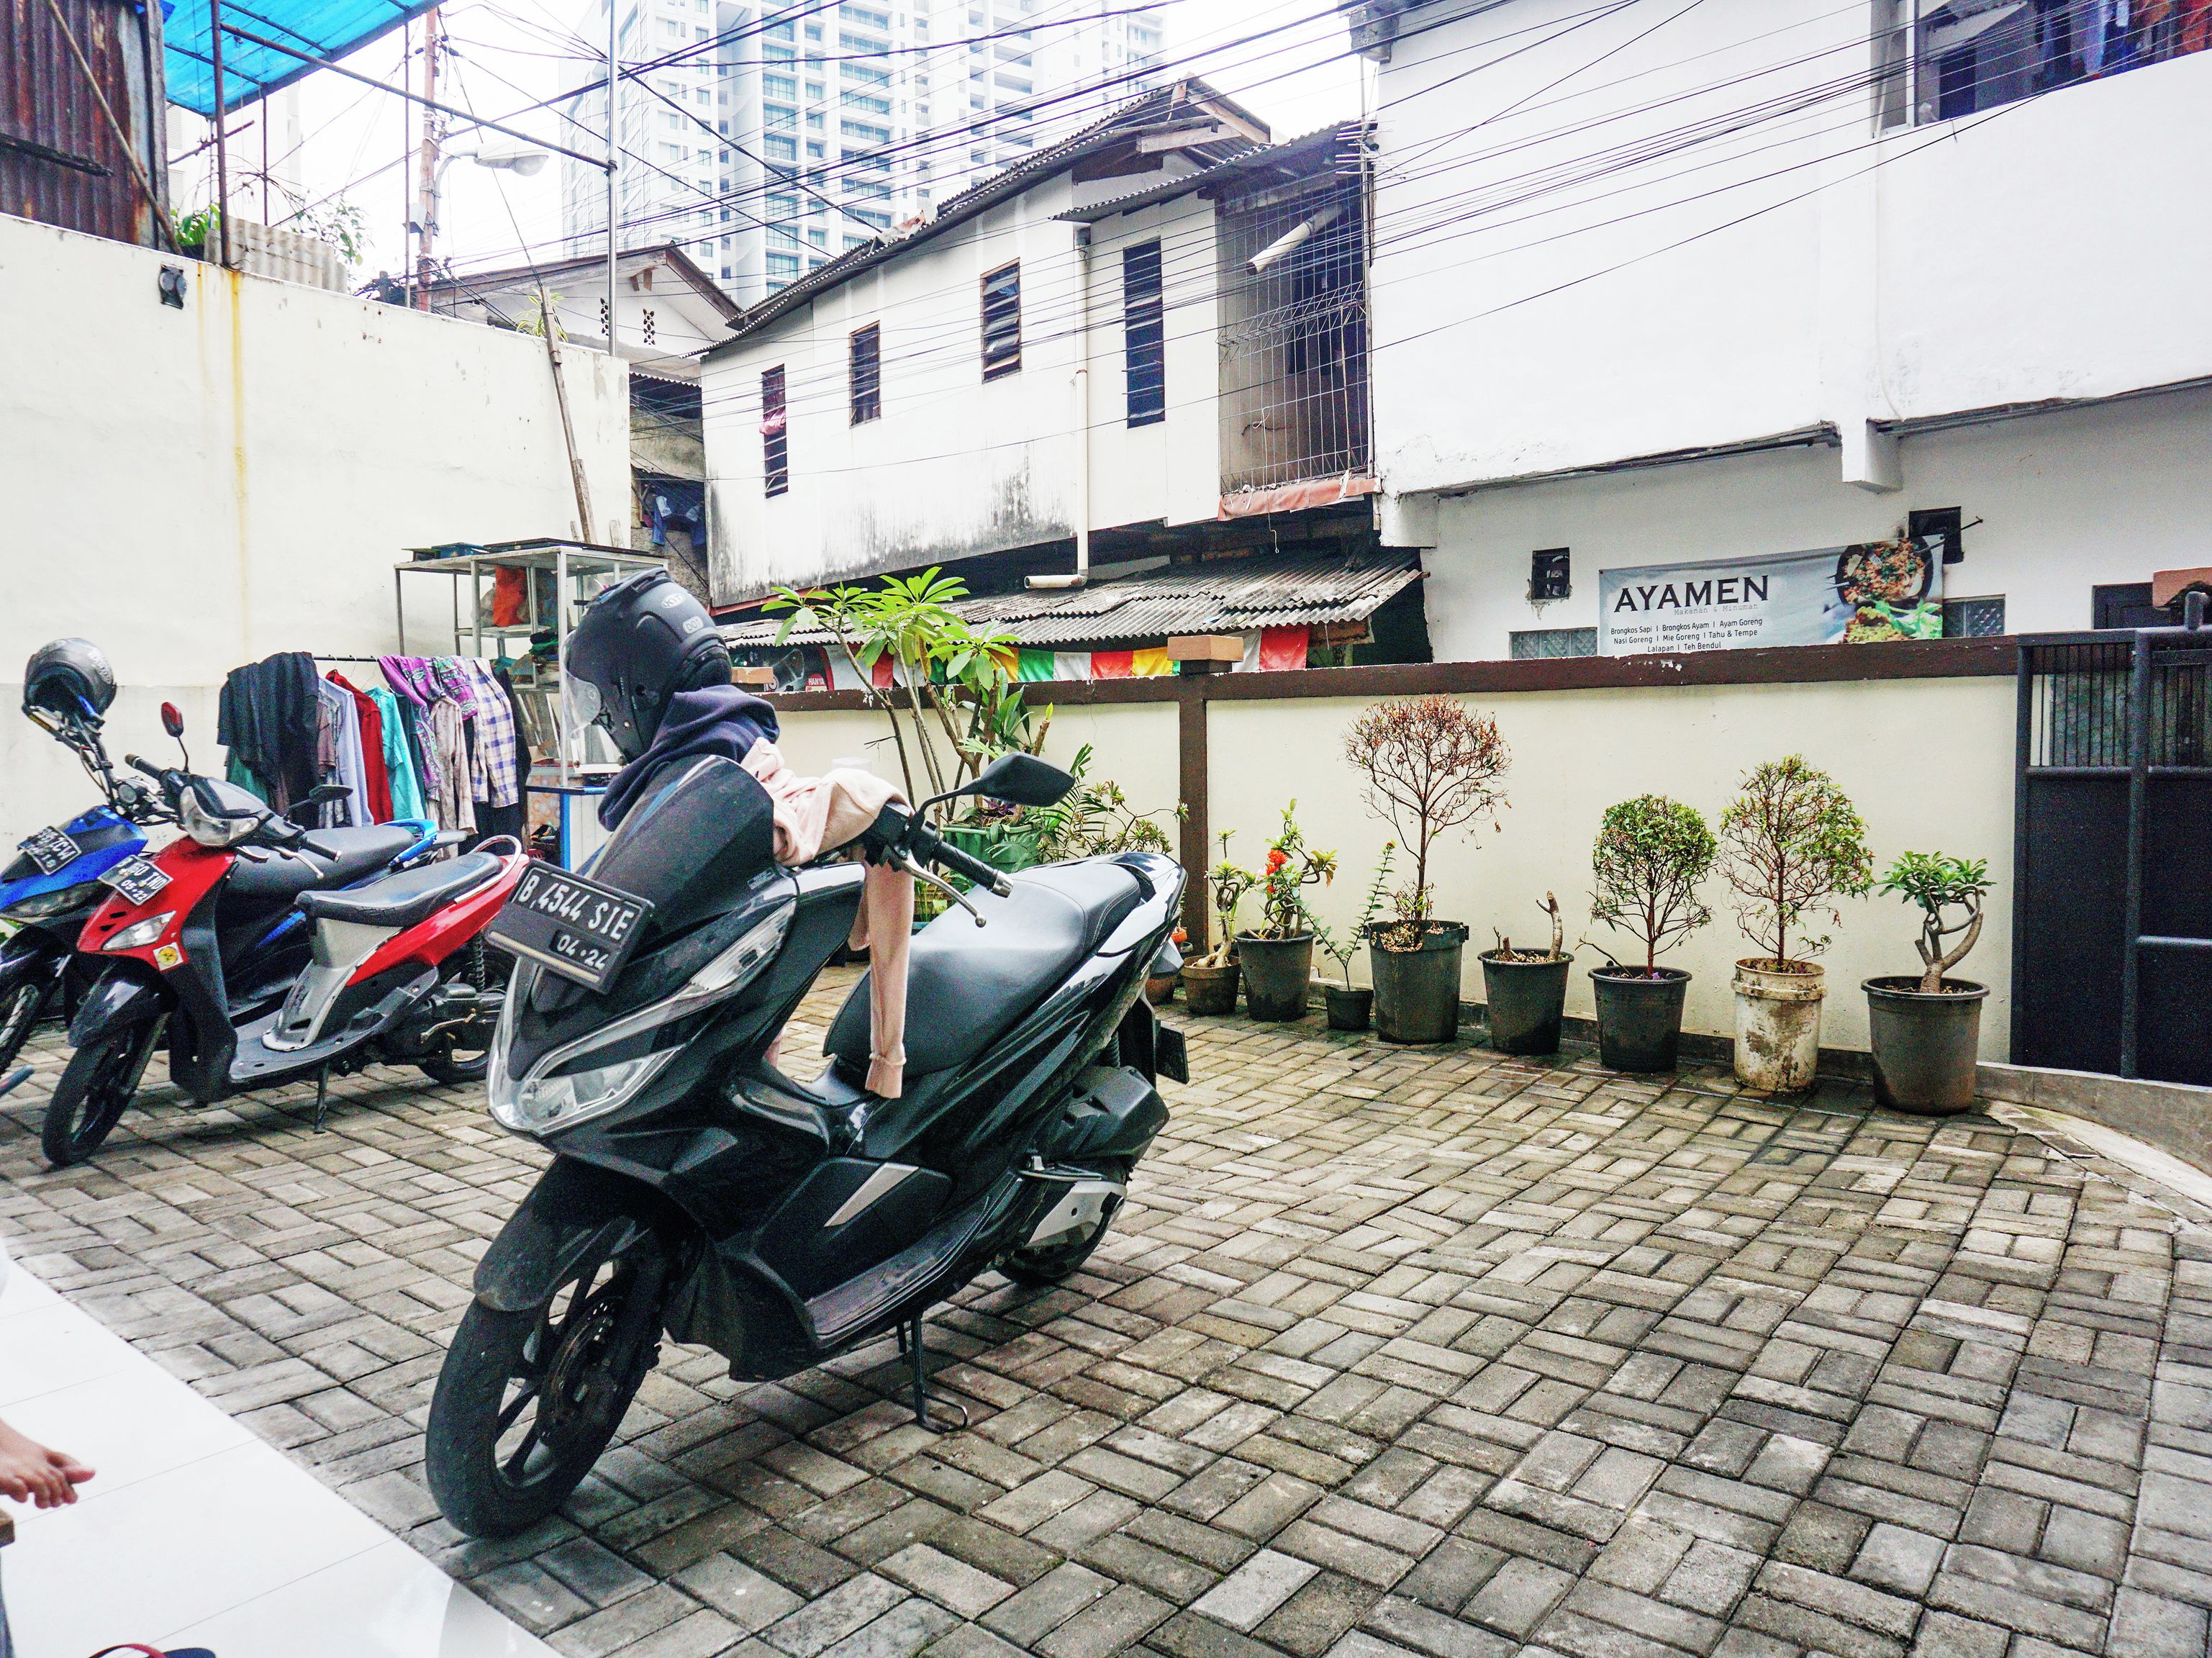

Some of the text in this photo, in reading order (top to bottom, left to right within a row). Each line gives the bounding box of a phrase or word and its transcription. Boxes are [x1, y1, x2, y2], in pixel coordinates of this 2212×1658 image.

[1613, 575, 1769, 613] AYAMEN
[1674, 607, 1708, 616] Makanan
[1723, 603, 1759, 612] Minuman
[1610, 627, 1638, 635] Brongkos
[1662, 622, 1691, 632] Brongkos
[1692, 621, 1710, 630] Ayam
[1719, 620, 1738, 628] Ayam
[1739, 618, 1763, 627] Goreng
[1628, 635, 1653, 644] Goreng
[1676, 633, 1700, 641] Goreng
[1709, 630, 1726, 639] Tahu
[1734, 628, 1758, 637] Tempe
[1697, 641, 1721, 650] Bendul
[808, 677, 825, 686] HANYA
[518, 874, 635, 941] B 4544 SIE
